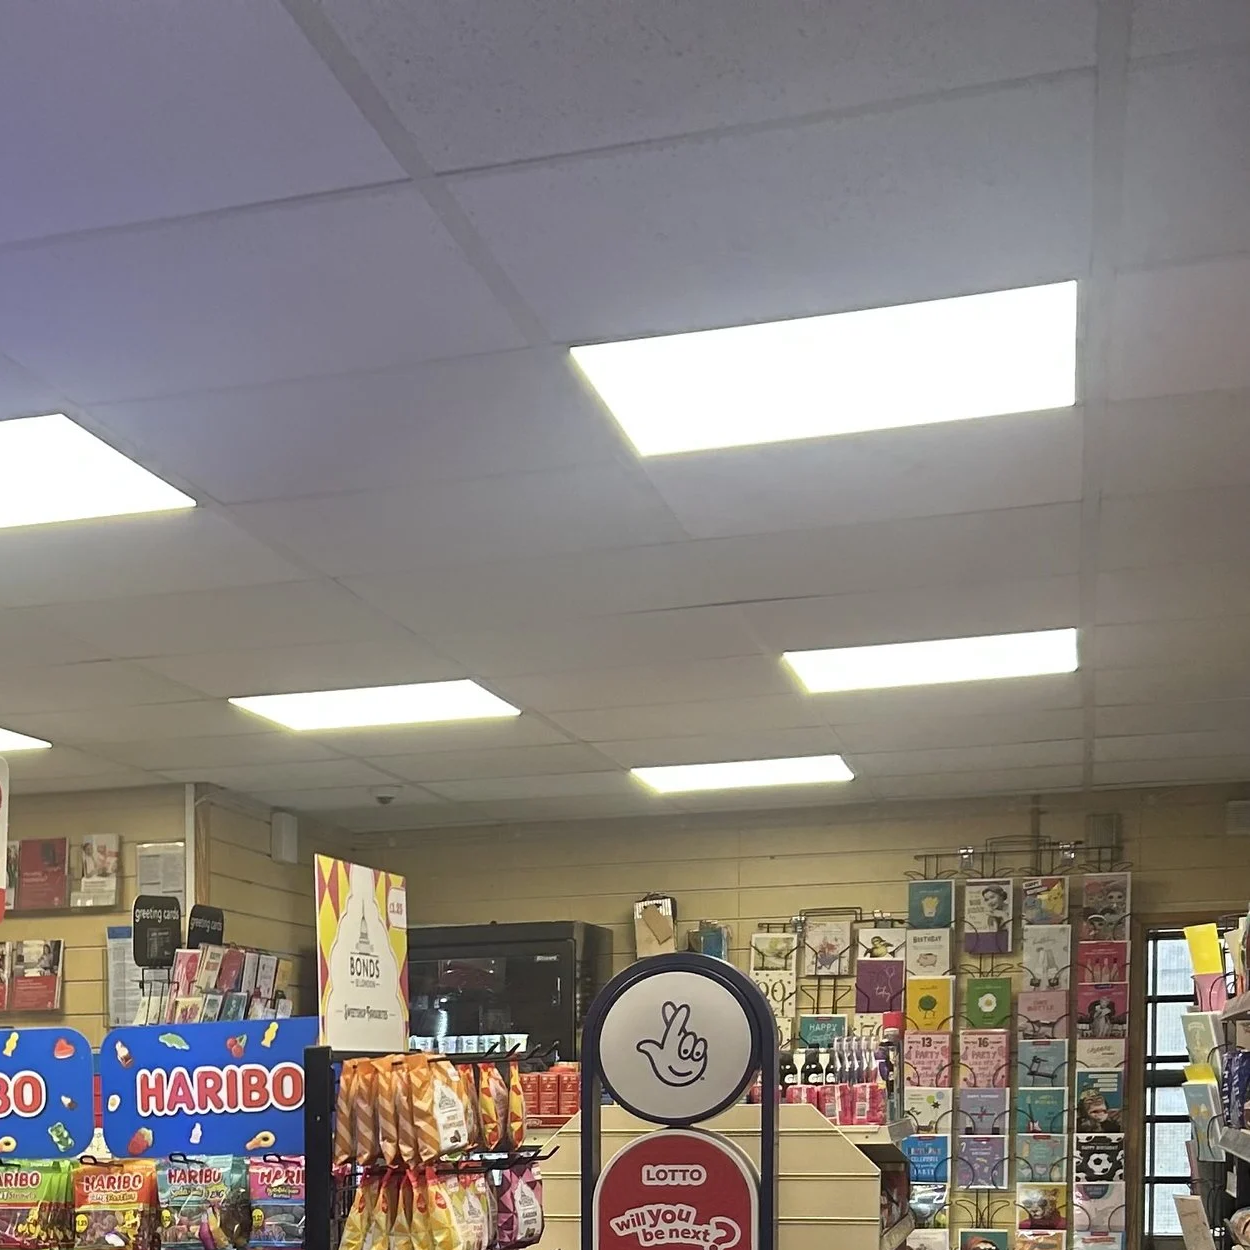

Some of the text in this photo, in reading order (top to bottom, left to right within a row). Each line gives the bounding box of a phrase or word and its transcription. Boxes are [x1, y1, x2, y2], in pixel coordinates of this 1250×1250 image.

[135, 907, 179, 923] greeting cards
[190, 917, 222, 932] greeting cards
[350, 956, 380, 978] BONDS
[809, 1023, 838, 1031] HAPPY
[921, 1037, 932, 1047] 13
[978, 1037, 989, 1047] 16
[137, 1062, 304, 1117] HARIBO
[84, 1174, 143, 1191] HARIBO
[167, 1168, 223, 1184] HARIBO
[646, 1169, 702, 1181] LOTTO
[615, 1208, 691, 1232] will you
[643, 1227, 665, 1242] be
